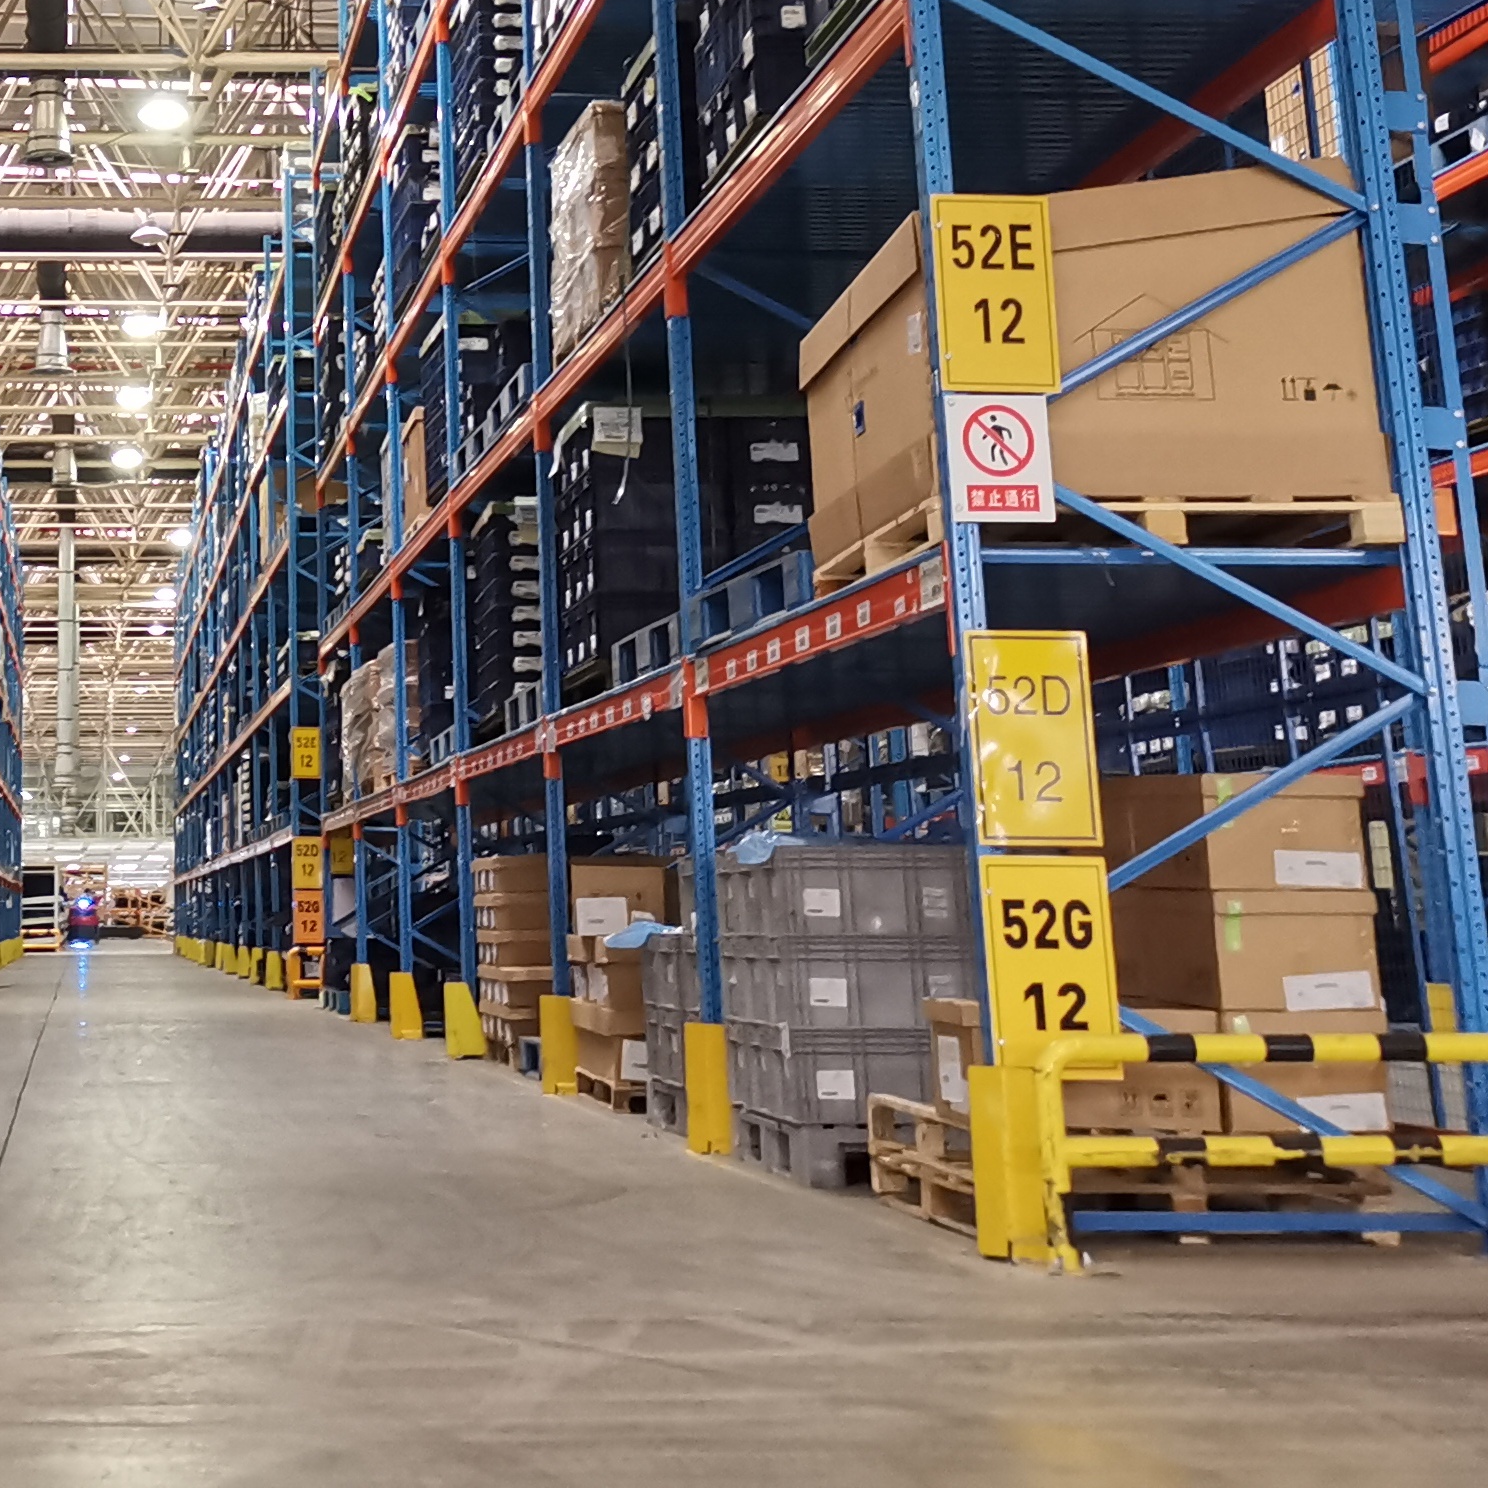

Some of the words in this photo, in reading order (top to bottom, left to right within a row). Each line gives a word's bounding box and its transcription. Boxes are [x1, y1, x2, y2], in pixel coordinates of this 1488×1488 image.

[951, 223, 1035, 270] 52E
[974, 297, 1026, 344] 12
[971, 489, 1035, 508] 禁止通行
[987, 675, 1071, 715] 52D
[296, 737, 316, 748] 52E
[301, 754, 313, 768] 12
[1007, 760, 1063, 802] 12
[296, 844, 319, 857] 52D
[301, 863, 315, 876] 12
[297, 901, 320, 913] 52G
[301, 920, 318, 932] 12
[1001, 899, 1093, 949] 52G
[1023, 982, 1089, 1031] 12
